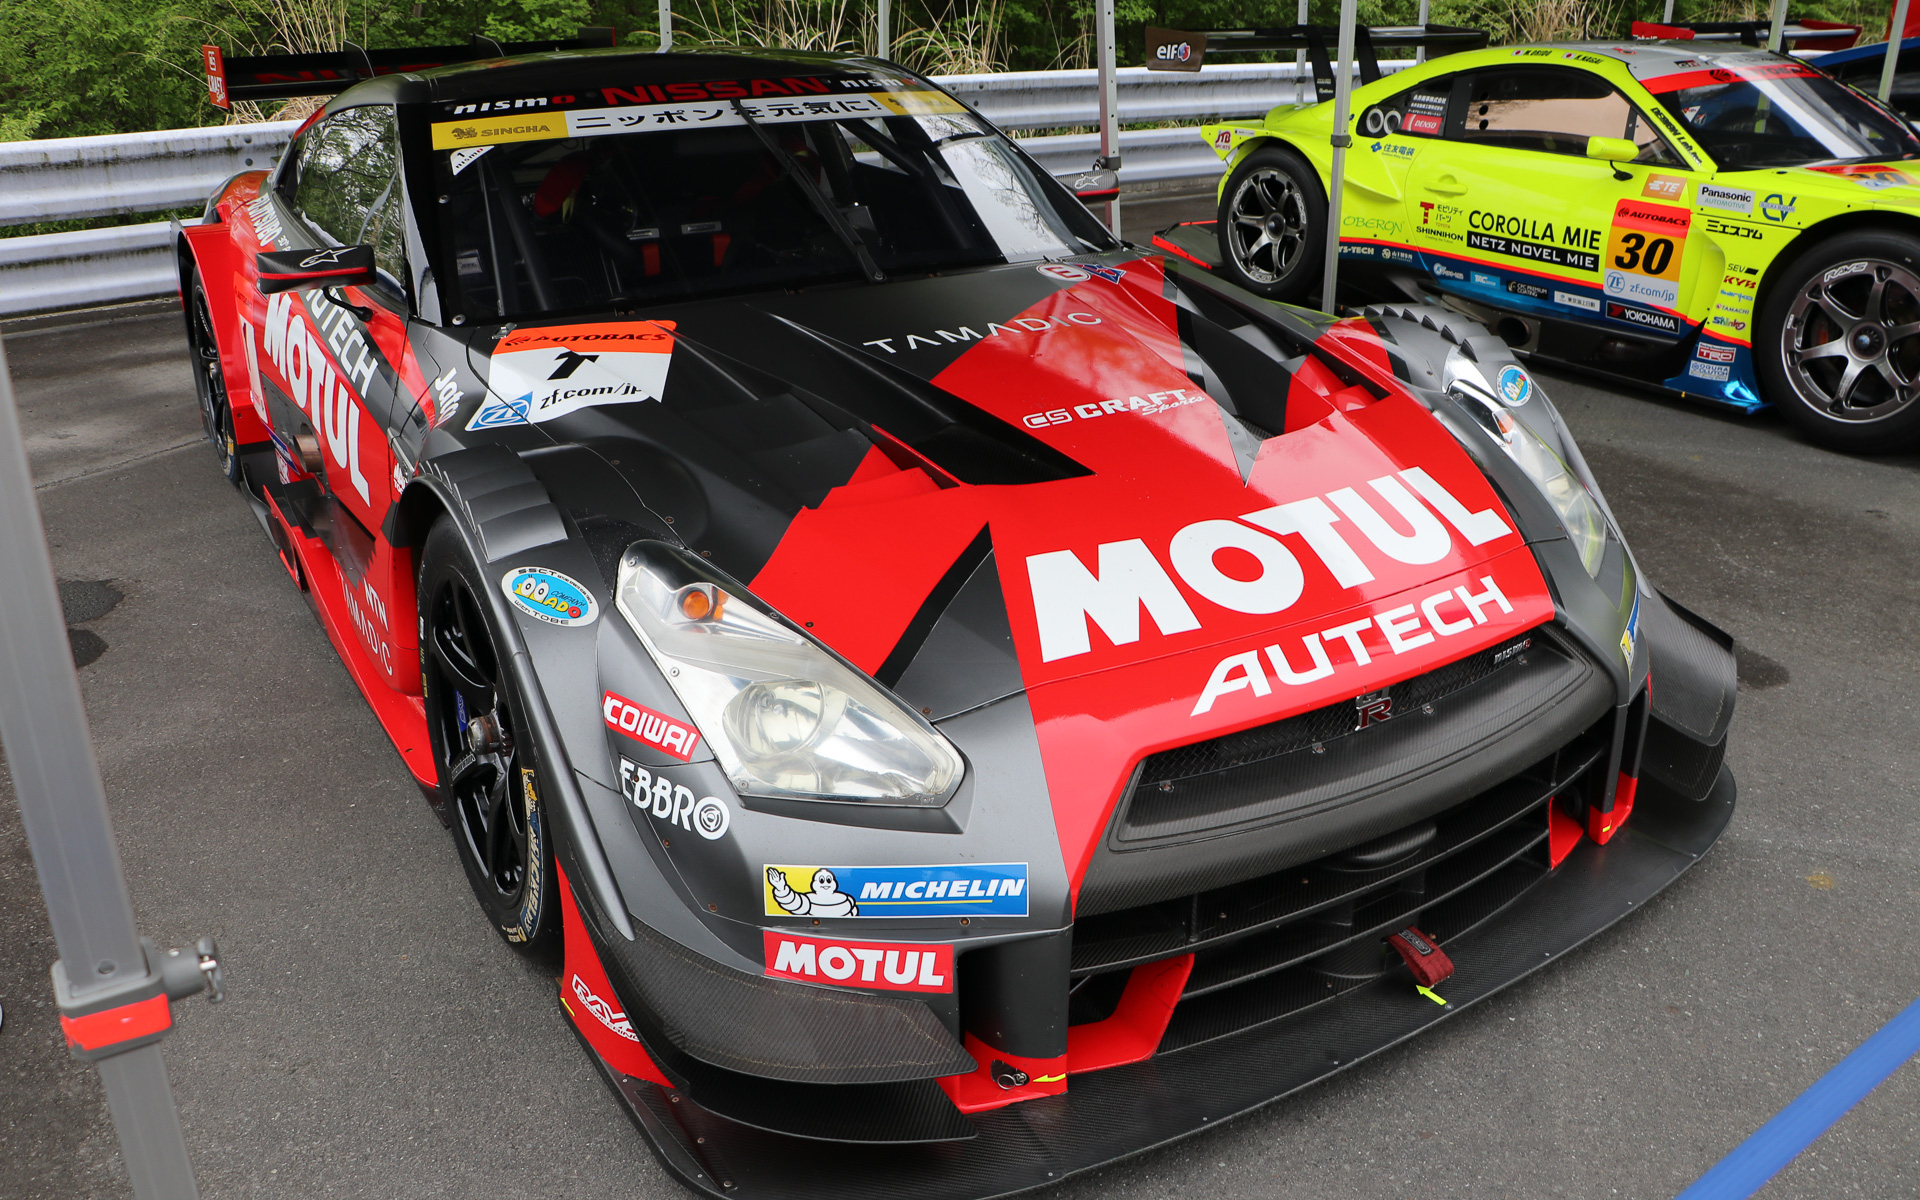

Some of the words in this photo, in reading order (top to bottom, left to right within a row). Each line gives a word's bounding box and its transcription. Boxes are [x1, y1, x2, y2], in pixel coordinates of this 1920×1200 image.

[1156, 44, 1178, 60] elf
[600, 77, 831, 106] NISSAN
[453, 96, 576, 115] nismo
[480, 124, 551, 138] SINGHA
[1414, 120, 1438, 130] DENSO
[1215, 131, 1231, 144] JTB
[455, 147, 484, 169] nismo
[1701, 186, 1752, 204] Panasonic
[1704, 197, 1747, 210] AUTOMOTIVE
[1630, 211, 1688, 227] AUTOBACS
[1416, 226, 1464, 241] SHINNIHON
[1468, 210, 1555, 243] COROLLA
[1562, 226, 1602, 250] MIE
[1470, 234, 1507, 251] NETZ
[1511, 243, 1560, 262] NOVEL
[1567, 256, 1595, 268] MIE
[1614, 232, 1674, 275] 30
[1824, 262, 1868, 282] RAYS
[1629, 284, 1676, 302] zf.com/jp
[1624, 308, 1676, 330] YOKOHAMA
[863, 312, 1102, 354] TAMADIC
[1699, 349, 1733, 362] TRD
[264, 292, 371, 508] MOTUL
[1073, 388, 1186, 420] CRAFT
[1141, 394, 1207, 417] Sports
[1025, 465, 1513, 664] MOTUL
[1190, 575, 1515, 718] AUTECH
[859, 878, 1026, 899] MICHELIN
[773, 940, 945, 987] MOTUL
